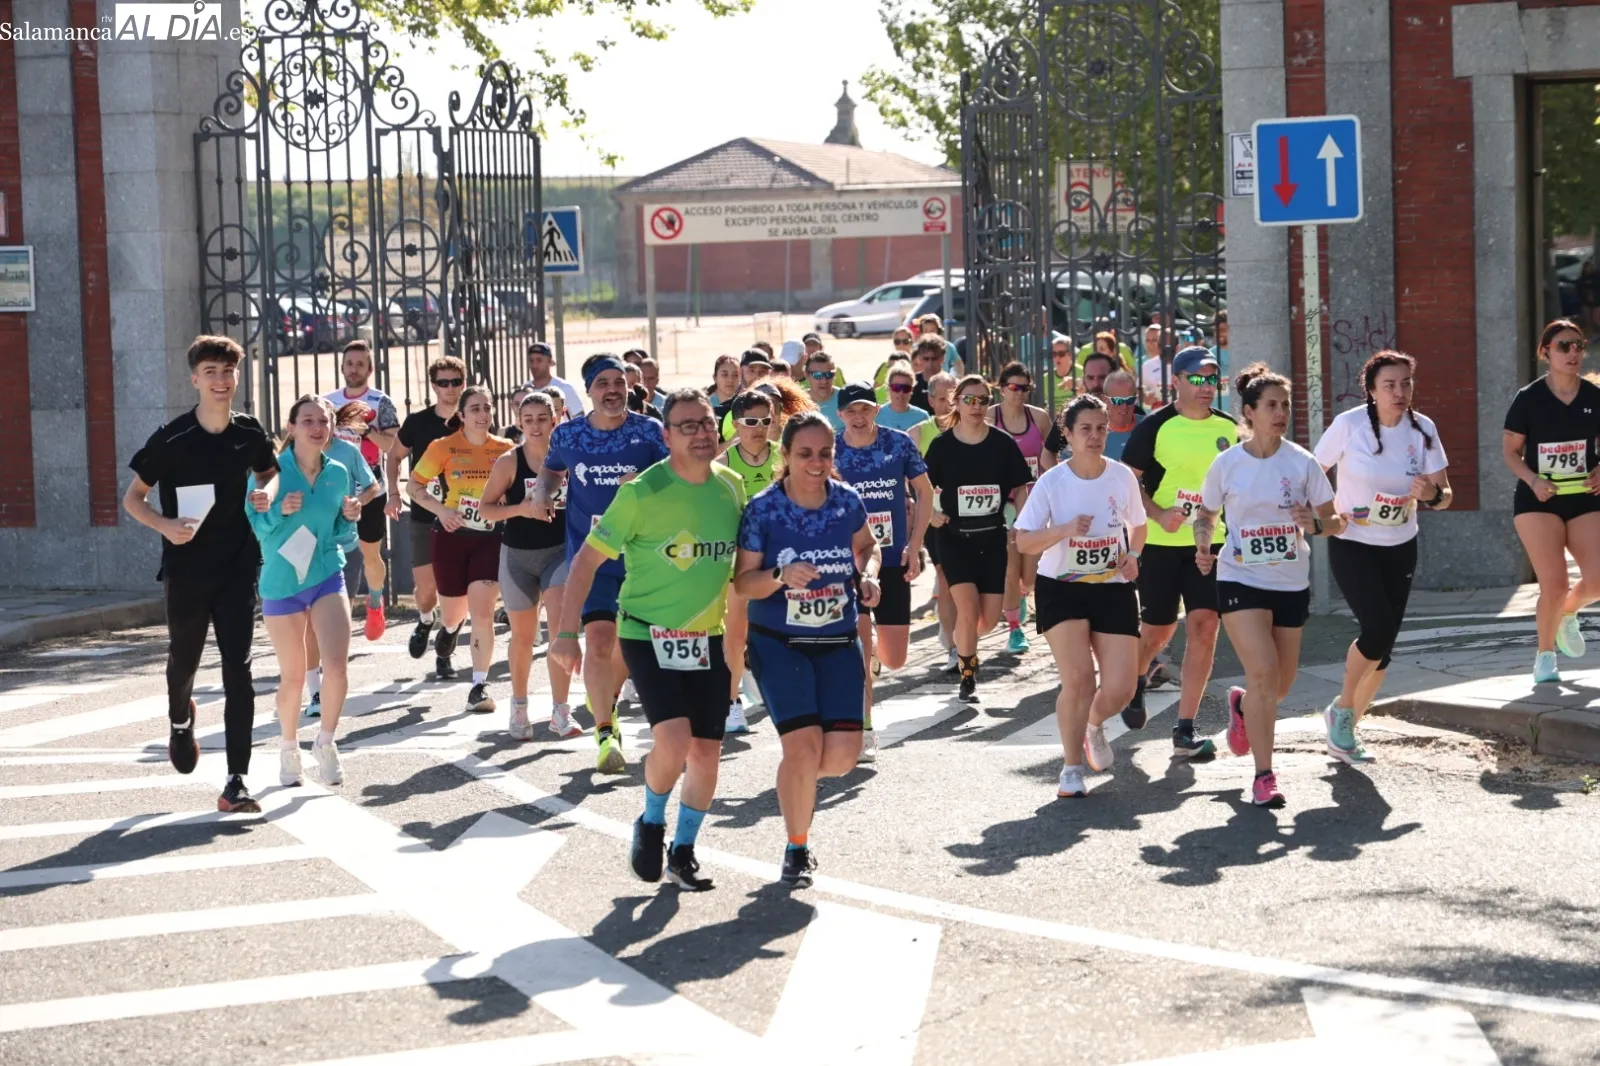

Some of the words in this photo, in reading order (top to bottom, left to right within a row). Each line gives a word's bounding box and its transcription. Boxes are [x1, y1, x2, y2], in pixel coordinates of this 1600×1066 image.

[684, 205, 722, 216] ACCESO
[724, 204, 776, 215] PROHIBIDO
[777, 203, 784, 213] A
[786, 202, 811, 213] TODA
[814, 201, 857, 212] PERSONA
[858, 200, 865, 210] Y
[724, 217, 767, 227] EXCEPTO
[769, 214, 818, 226] PERSONAL
[821, 213, 839, 224] DEL
[841, 212, 879, 223] CENTRO
[768, 227, 780, 237] SE
[782, 226, 808, 237] AVISA
[1547, 452, 1578, 468] 798
[589, 462, 638, 477] apaches
[593, 475, 620, 486] runni
[965, 495, 994, 509] 797
[1379, 504, 1406, 521] 87
[1240, 525, 1295, 539] bedunia
[664, 538, 736, 562] campa
[1068, 536, 1118, 549] bedunia
[1250, 535, 1288, 555] 858
[799, 545, 852, 564] apaches
[1076, 546, 1111, 566] 859
[799, 598, 840, 617] 802
[662, 638, 702, 660] 956
